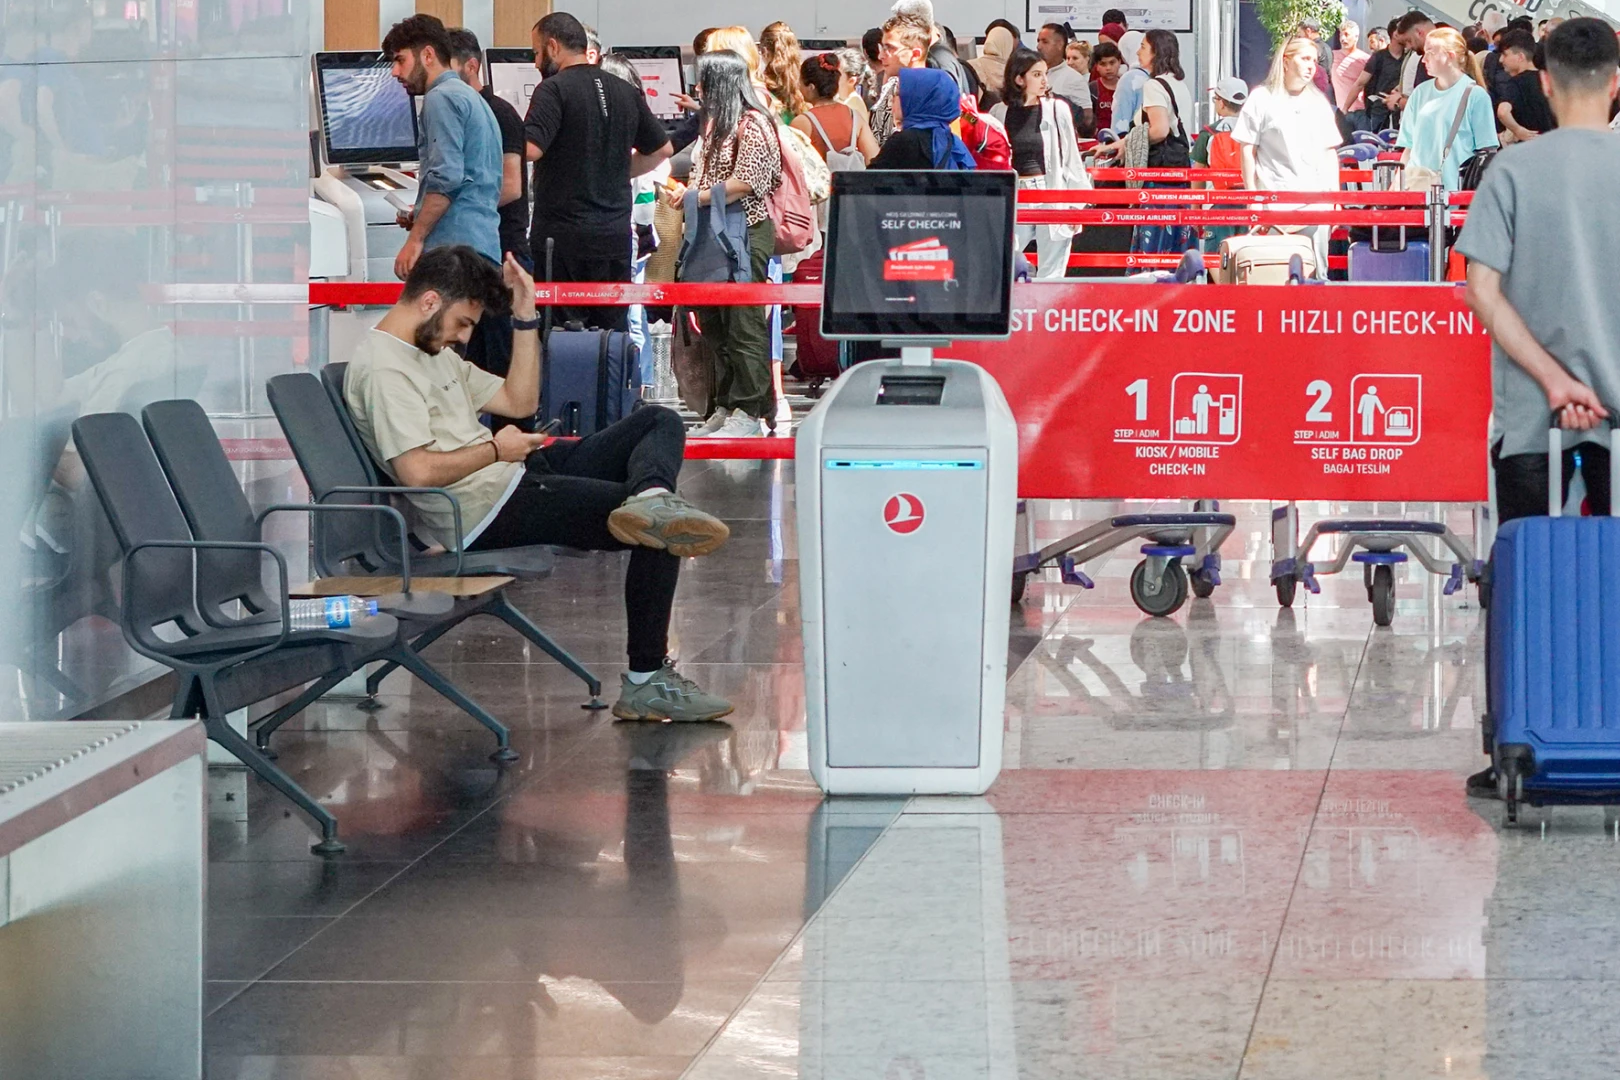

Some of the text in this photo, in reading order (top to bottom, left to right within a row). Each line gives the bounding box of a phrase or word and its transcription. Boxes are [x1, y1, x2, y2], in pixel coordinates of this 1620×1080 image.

[881, 220, 962, 229] SELF CHECK-IN
[1011, 308, 1473, 335] ST CHECK-IN ZONE HIZLI CHECK-IN
[1125, 378, 1148, 421] 1
[1306, 379, 1333, 422] 2
[1114, 429, 1160, 438] STEP ADIM
[1294, 430, 1339, 439] STEP ADIM
[1135, 447, 1168, 459] KIOSK
[1178, 446, 1220, 459] MOBILE
[1311, 448, 1403, 460] SELF BAG DROP
[1149, 463, 1206, 475] CHECK-IN
[1323, 461, 1391, 475] BAGAJ TESLİM
